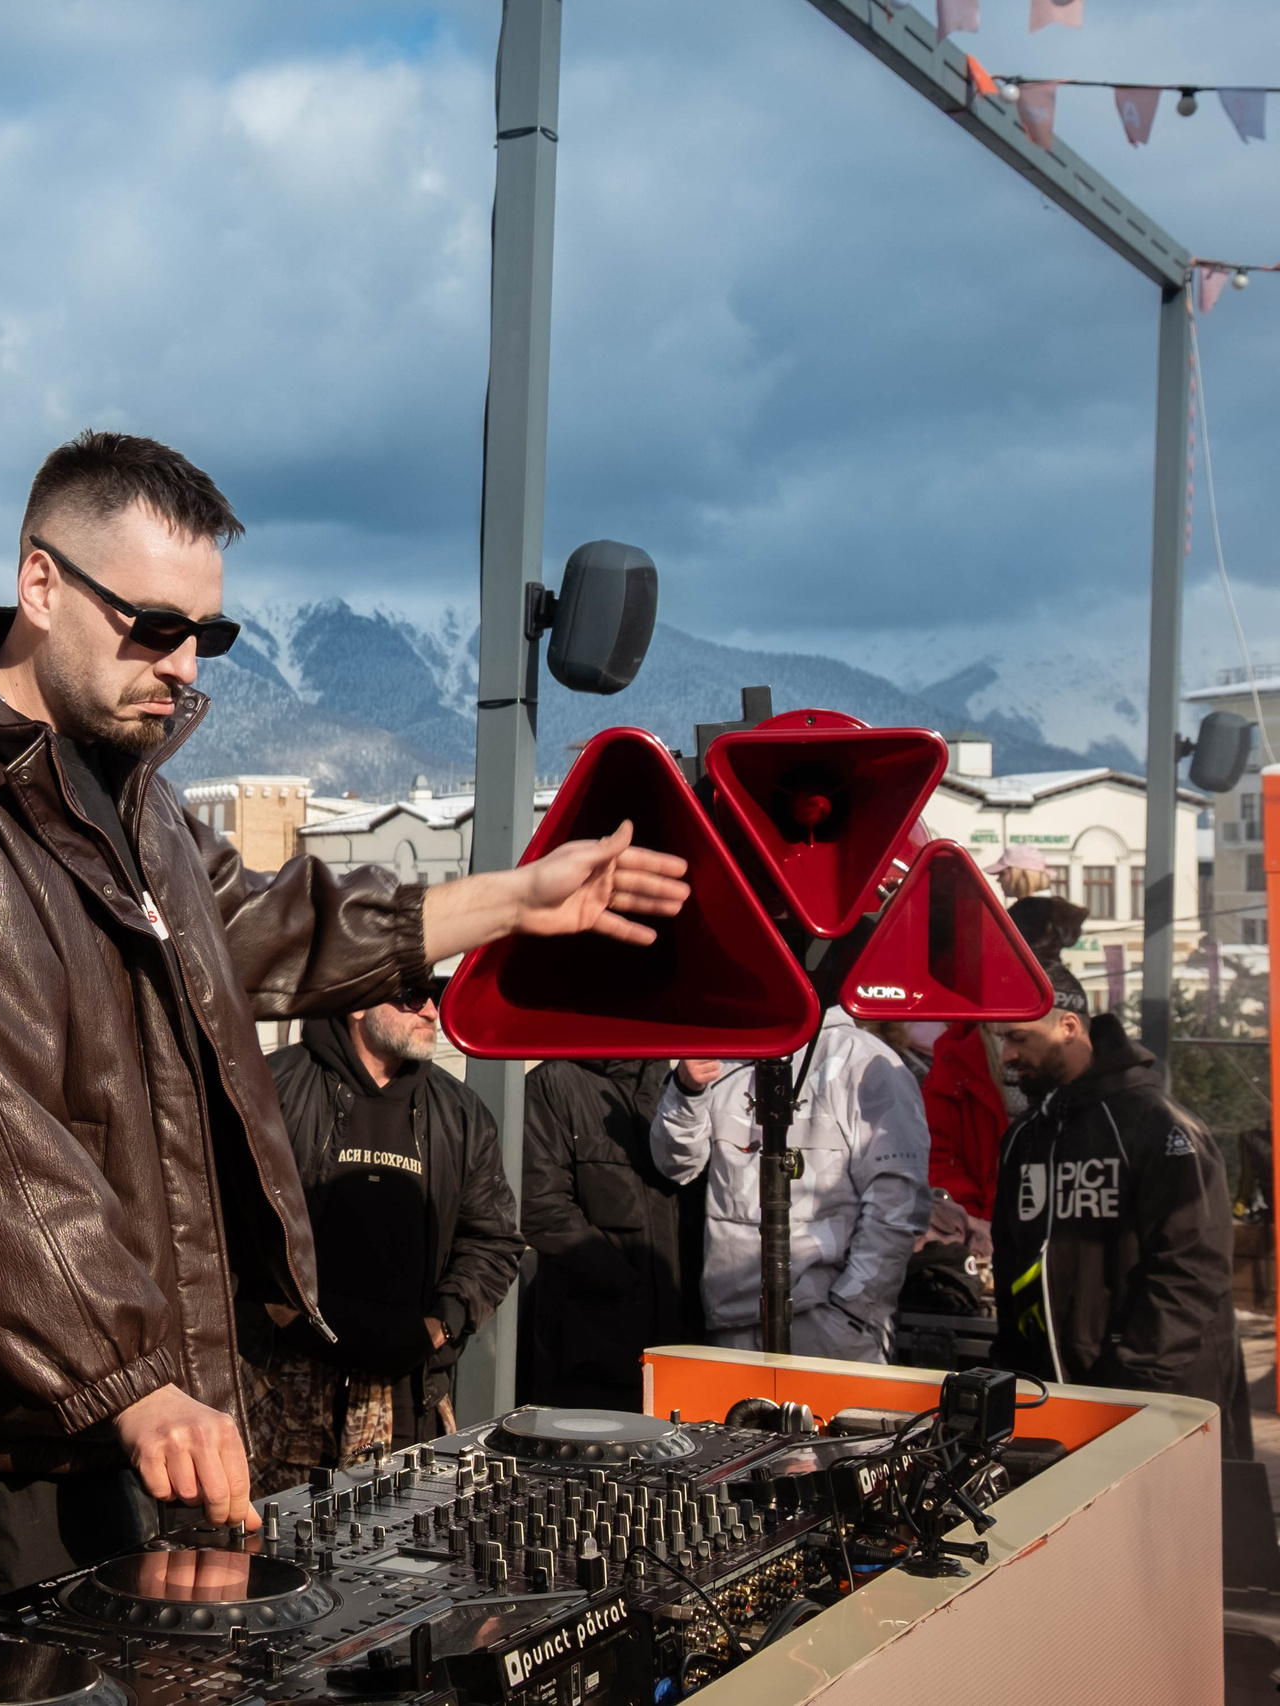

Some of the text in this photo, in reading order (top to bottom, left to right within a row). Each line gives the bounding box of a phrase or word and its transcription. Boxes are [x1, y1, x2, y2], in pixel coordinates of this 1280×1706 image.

[856, 985, 906, 999] VOID
[1056, 1158, 1120, 1190] PICT
[1056, 1188, 1120, 1219] URE
[522, 1598, 628, 1678] punct pătrat
